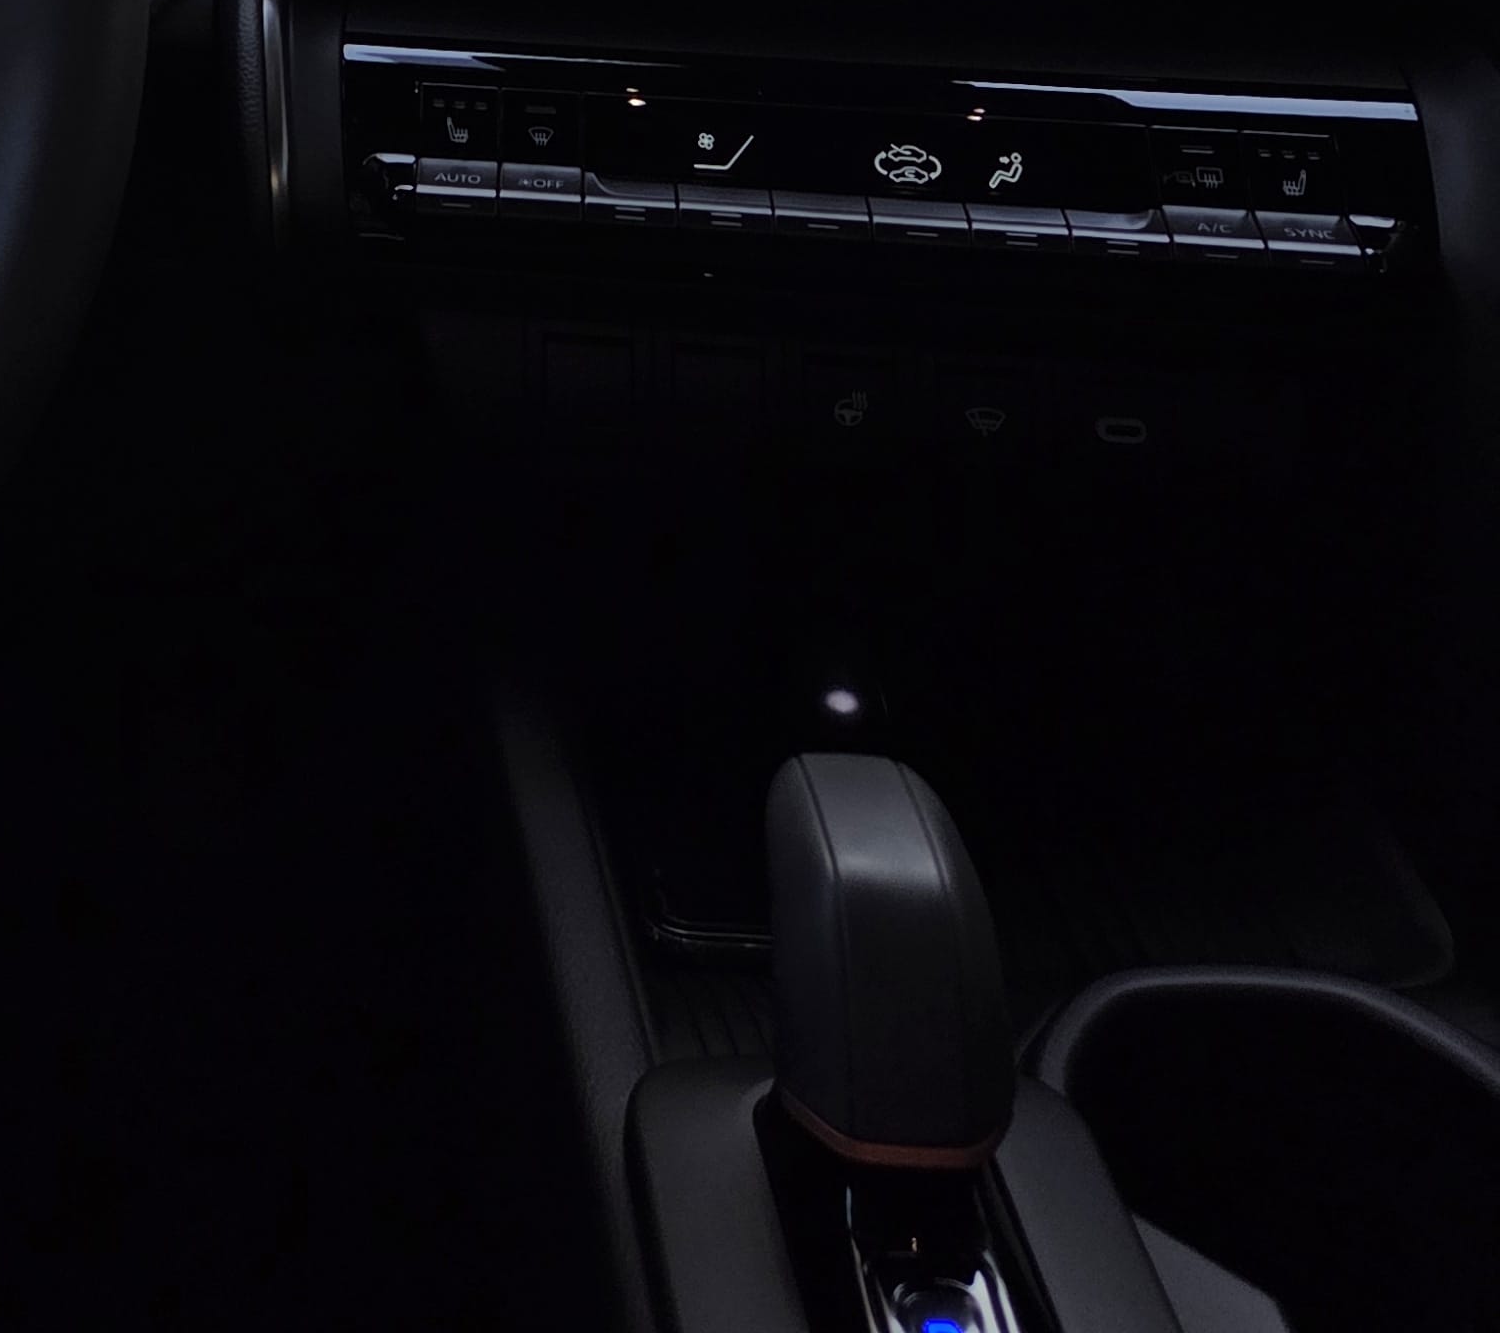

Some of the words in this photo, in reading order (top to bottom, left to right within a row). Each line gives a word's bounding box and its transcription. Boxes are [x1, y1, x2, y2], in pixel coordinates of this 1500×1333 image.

[434, 172, 481, 185] AUTO
[532, 178, 564, 189] OFF
[1197, 222, 1233, 234] A/C
[1284, 227, 1336, 240] SYNC
